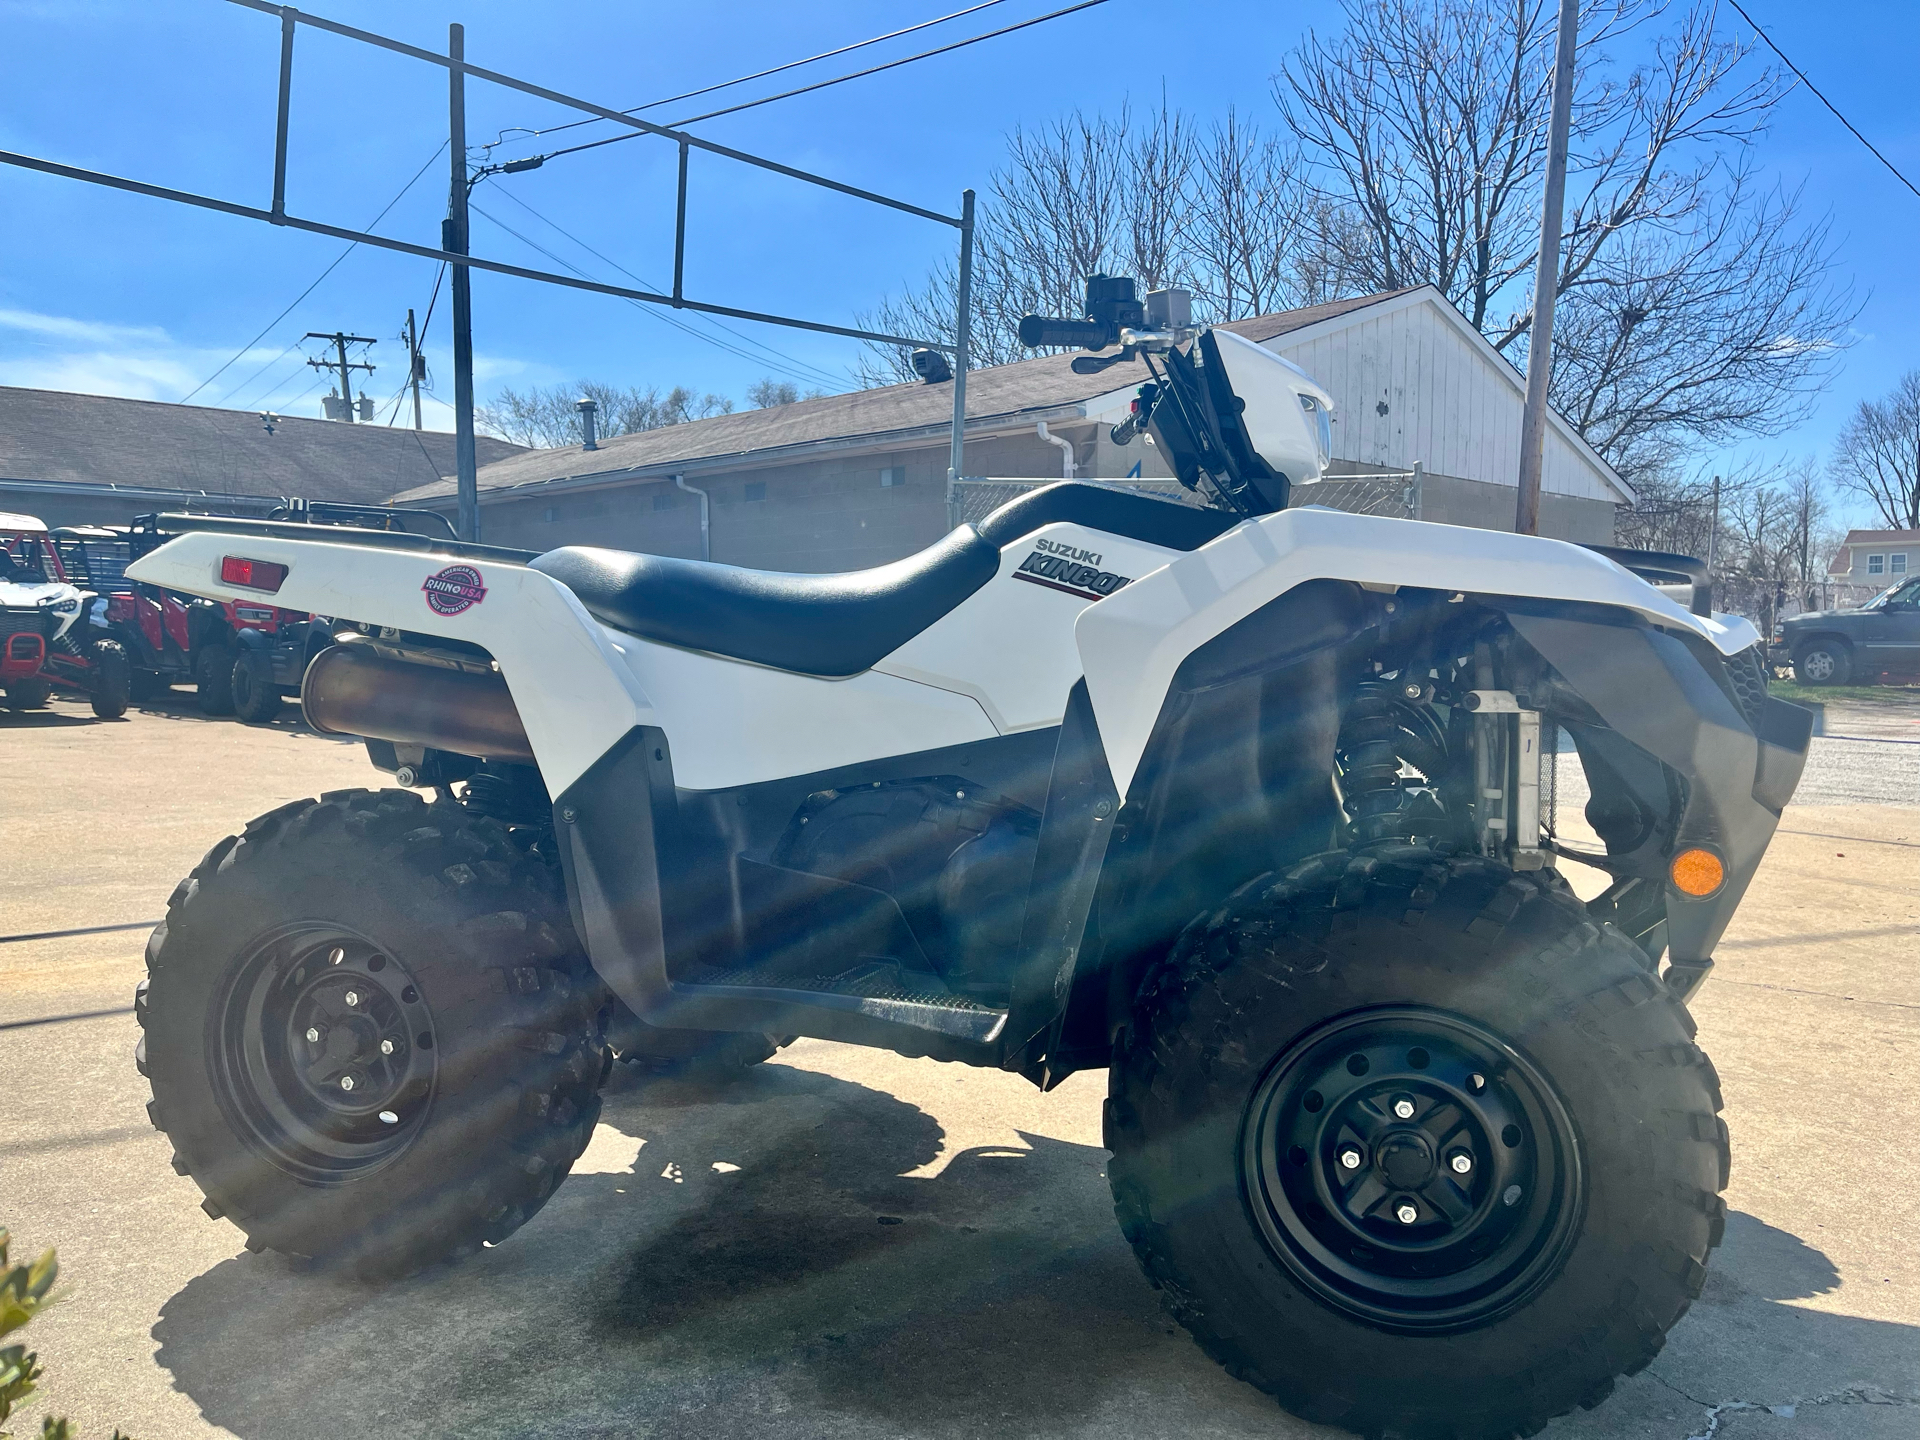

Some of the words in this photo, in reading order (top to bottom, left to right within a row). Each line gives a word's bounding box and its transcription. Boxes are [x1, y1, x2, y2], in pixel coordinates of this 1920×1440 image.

[1035, 538, 1103, 566] SUZUKI
[441, 566, 470, 578] AMERICAN
[429, 593, 441, 610] FAMILY
[440, 600, 469, 613] OPERATED
